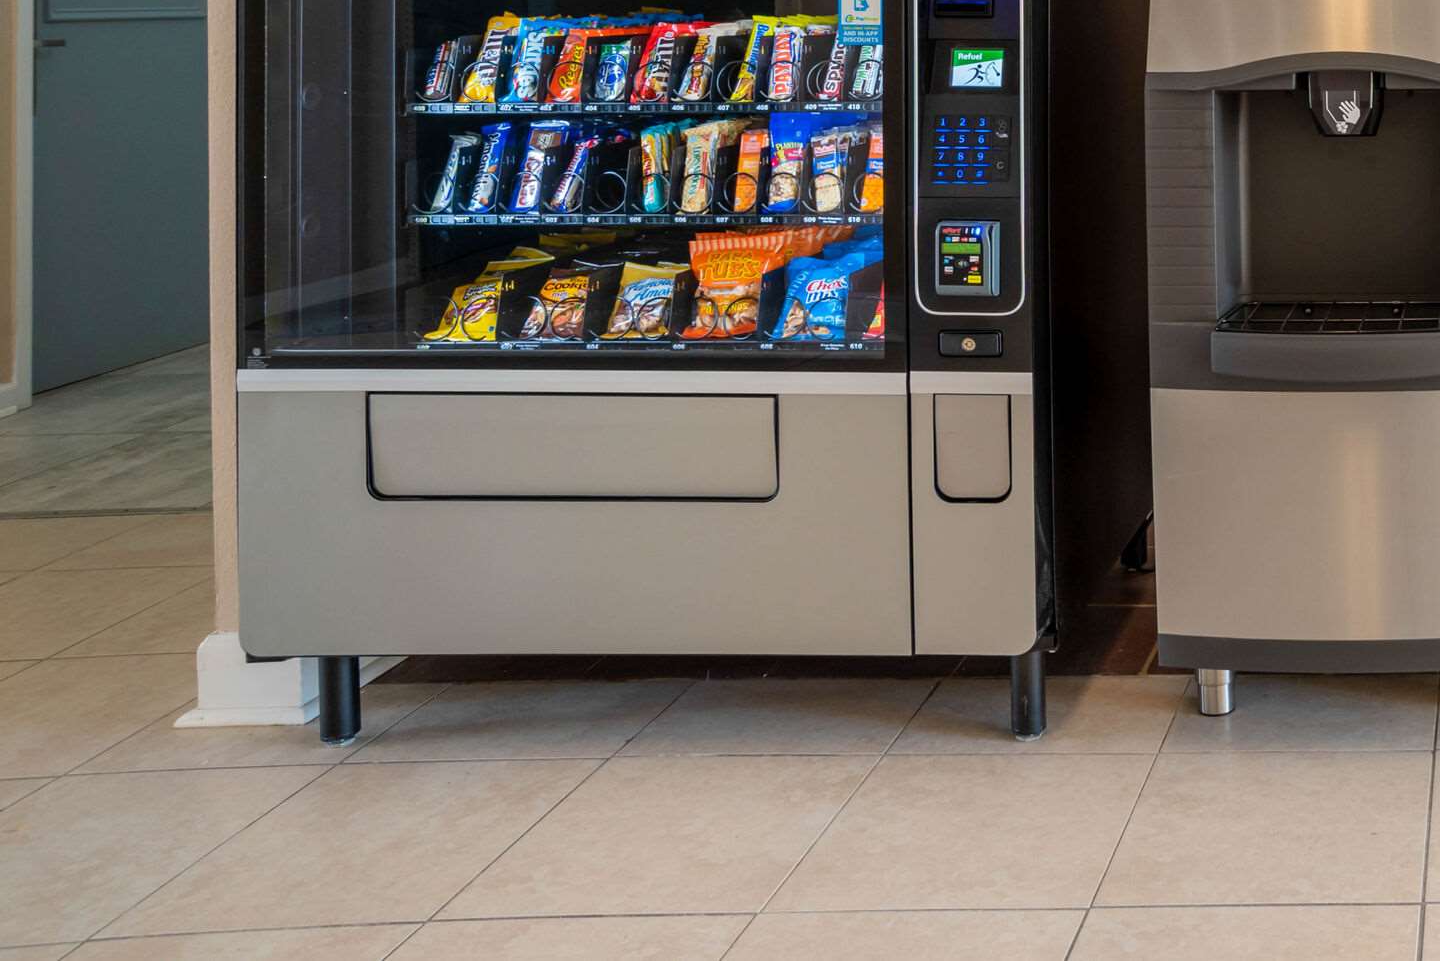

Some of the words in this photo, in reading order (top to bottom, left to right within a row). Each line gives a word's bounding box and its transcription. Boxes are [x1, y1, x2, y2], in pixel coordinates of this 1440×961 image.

[825, 42, 845, 93] ounds
[996, 161, 1004, 170] C
[806, 277, 848, 292] Chex
